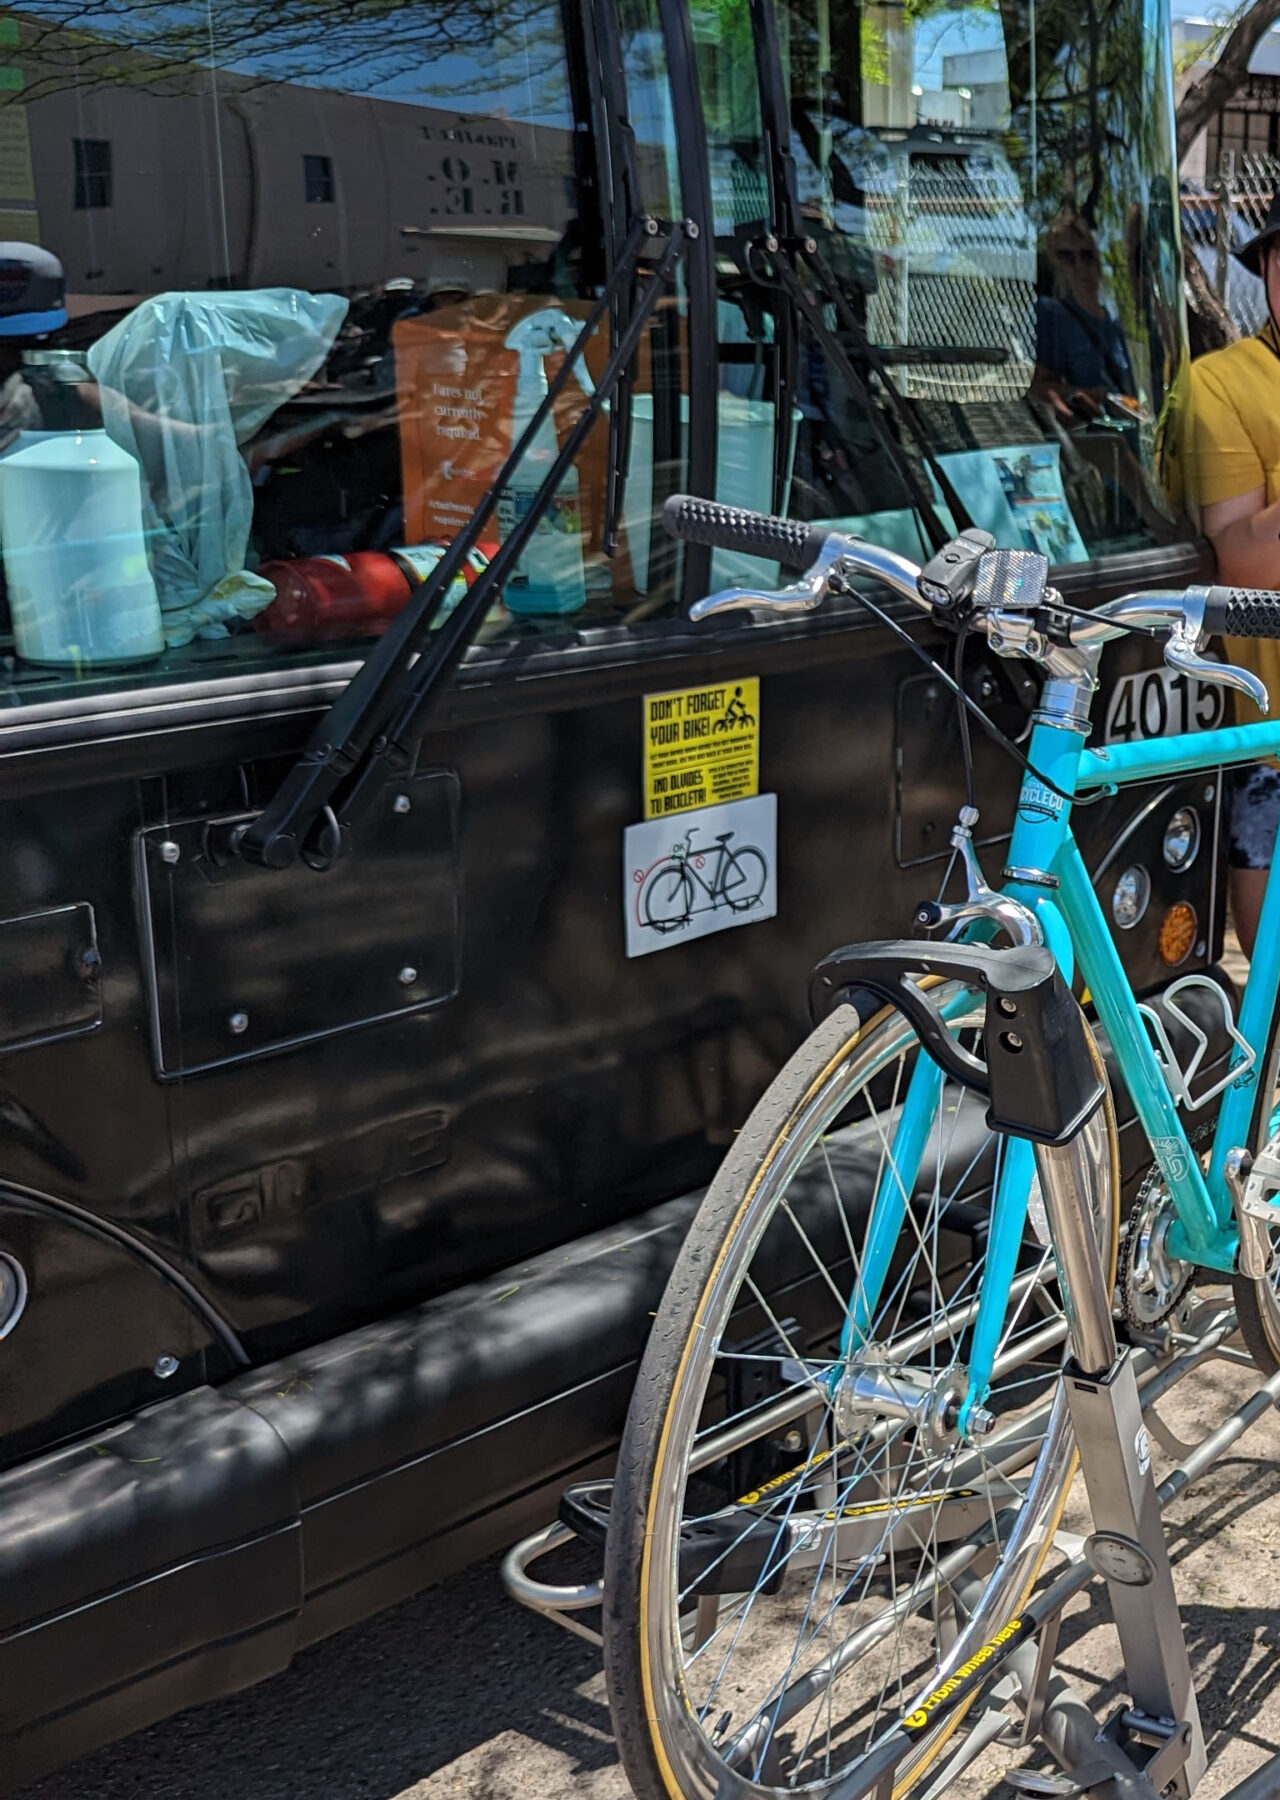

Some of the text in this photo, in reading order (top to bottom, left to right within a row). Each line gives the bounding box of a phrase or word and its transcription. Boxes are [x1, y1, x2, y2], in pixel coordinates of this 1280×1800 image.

[650, 689, 726, 722] DON'T FORGET
[1111, 672, 1222, 743] 4015
[650, 722, 680, 747] YOUR
[650, 799, 662, 815] TU
[922, 1678, 962, 1711] Front
[990, 1620, 1022, 1646] here
